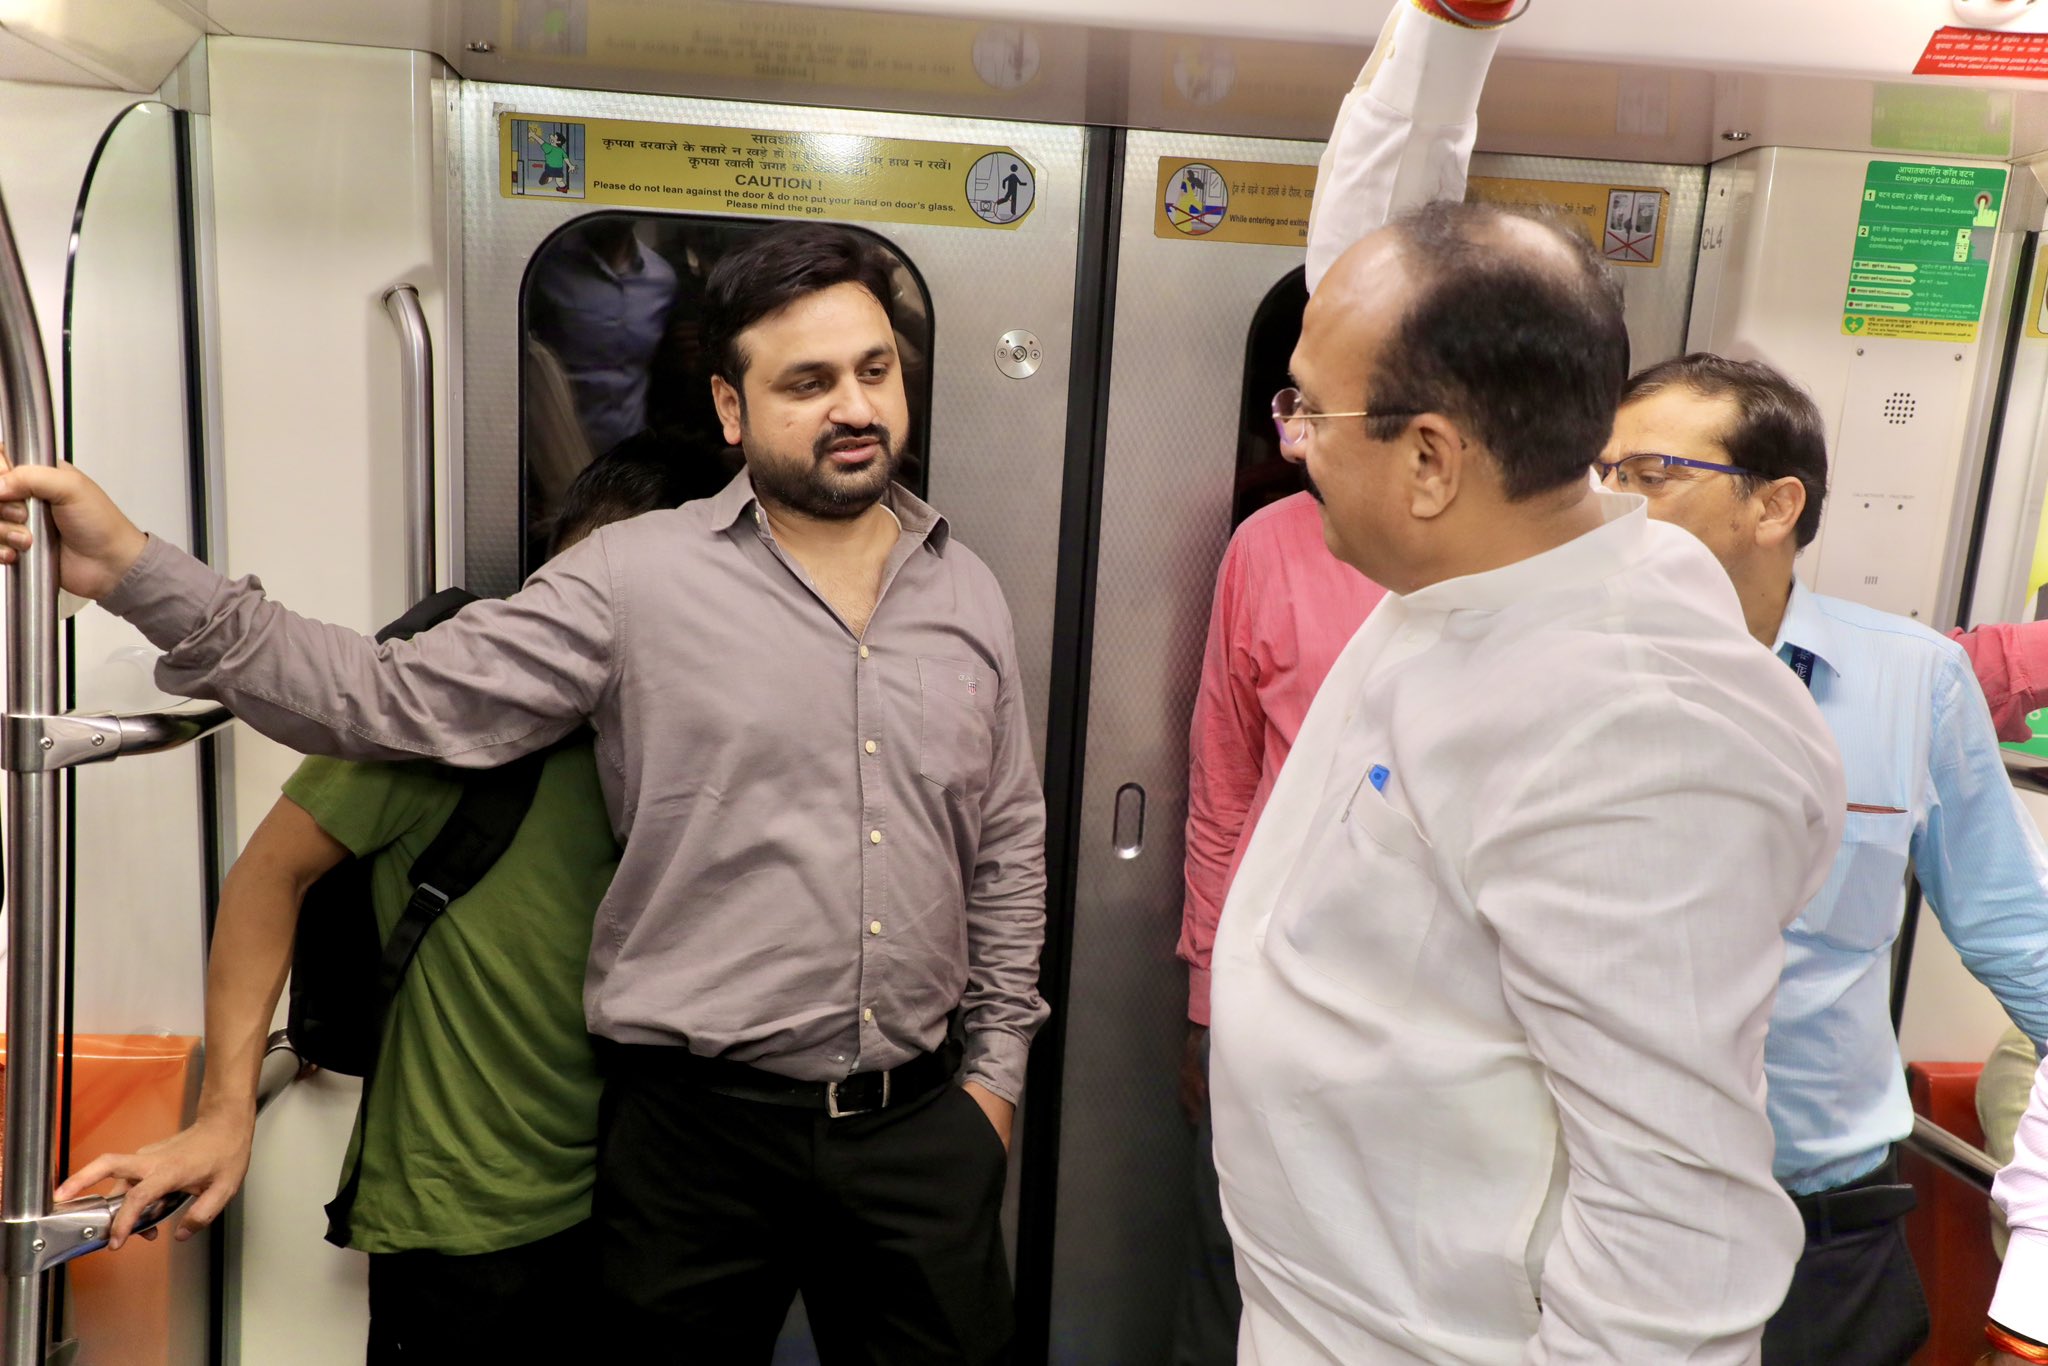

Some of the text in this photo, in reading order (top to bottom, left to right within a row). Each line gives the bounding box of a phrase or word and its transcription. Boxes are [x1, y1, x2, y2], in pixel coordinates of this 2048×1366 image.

[602, 138, 634, 150] कृपया
[683, 141, 695, 152] के
[700, 143, 727, 155] सहारे
[732, 147, 741, 155] न
[688, 156, 720, 169] कृपया
[725, 158, 754, 169] खाली
[760, 161, 786, 171] जगह
[888, 158, 908, 167] हाथ
[914, 160, 922, 168] न
[1898, 166, 1940, 176] आपातकालीन
[1943, 167, 1957, 177] कॉल
[735, 174, 811, 190] CAUTION
[1895, 174, 1934, 184] Emergency
[1951, 177, 1975, 186] Button
[593, 180, 626, 190] Please
[629, 183, 641, 191] do
[644, 185, 660, 193] not
[663, 185, 683, 194] lean
[686, 187, 721, 197] against
[724, 189, 740, 198] the
[743, 190, 765, 199] door
[768, 192, 774, 200] &
[778, 192, 790, 201] do
[793, 194, 808, 202] not
[811, 195, 826, 204] put
[829, 197, 850, 206] your
[854, 197, 877, 206] hand
[895, 200, 925, 209] door's
[928, 202, 956, 212] glass.
[726, 200, 826, 214] Please mind the gap.
[1229, 214, 1247, 223] While
[1248, 216, 1275, 226] entering
[1276, 218, 1288, 226] and
